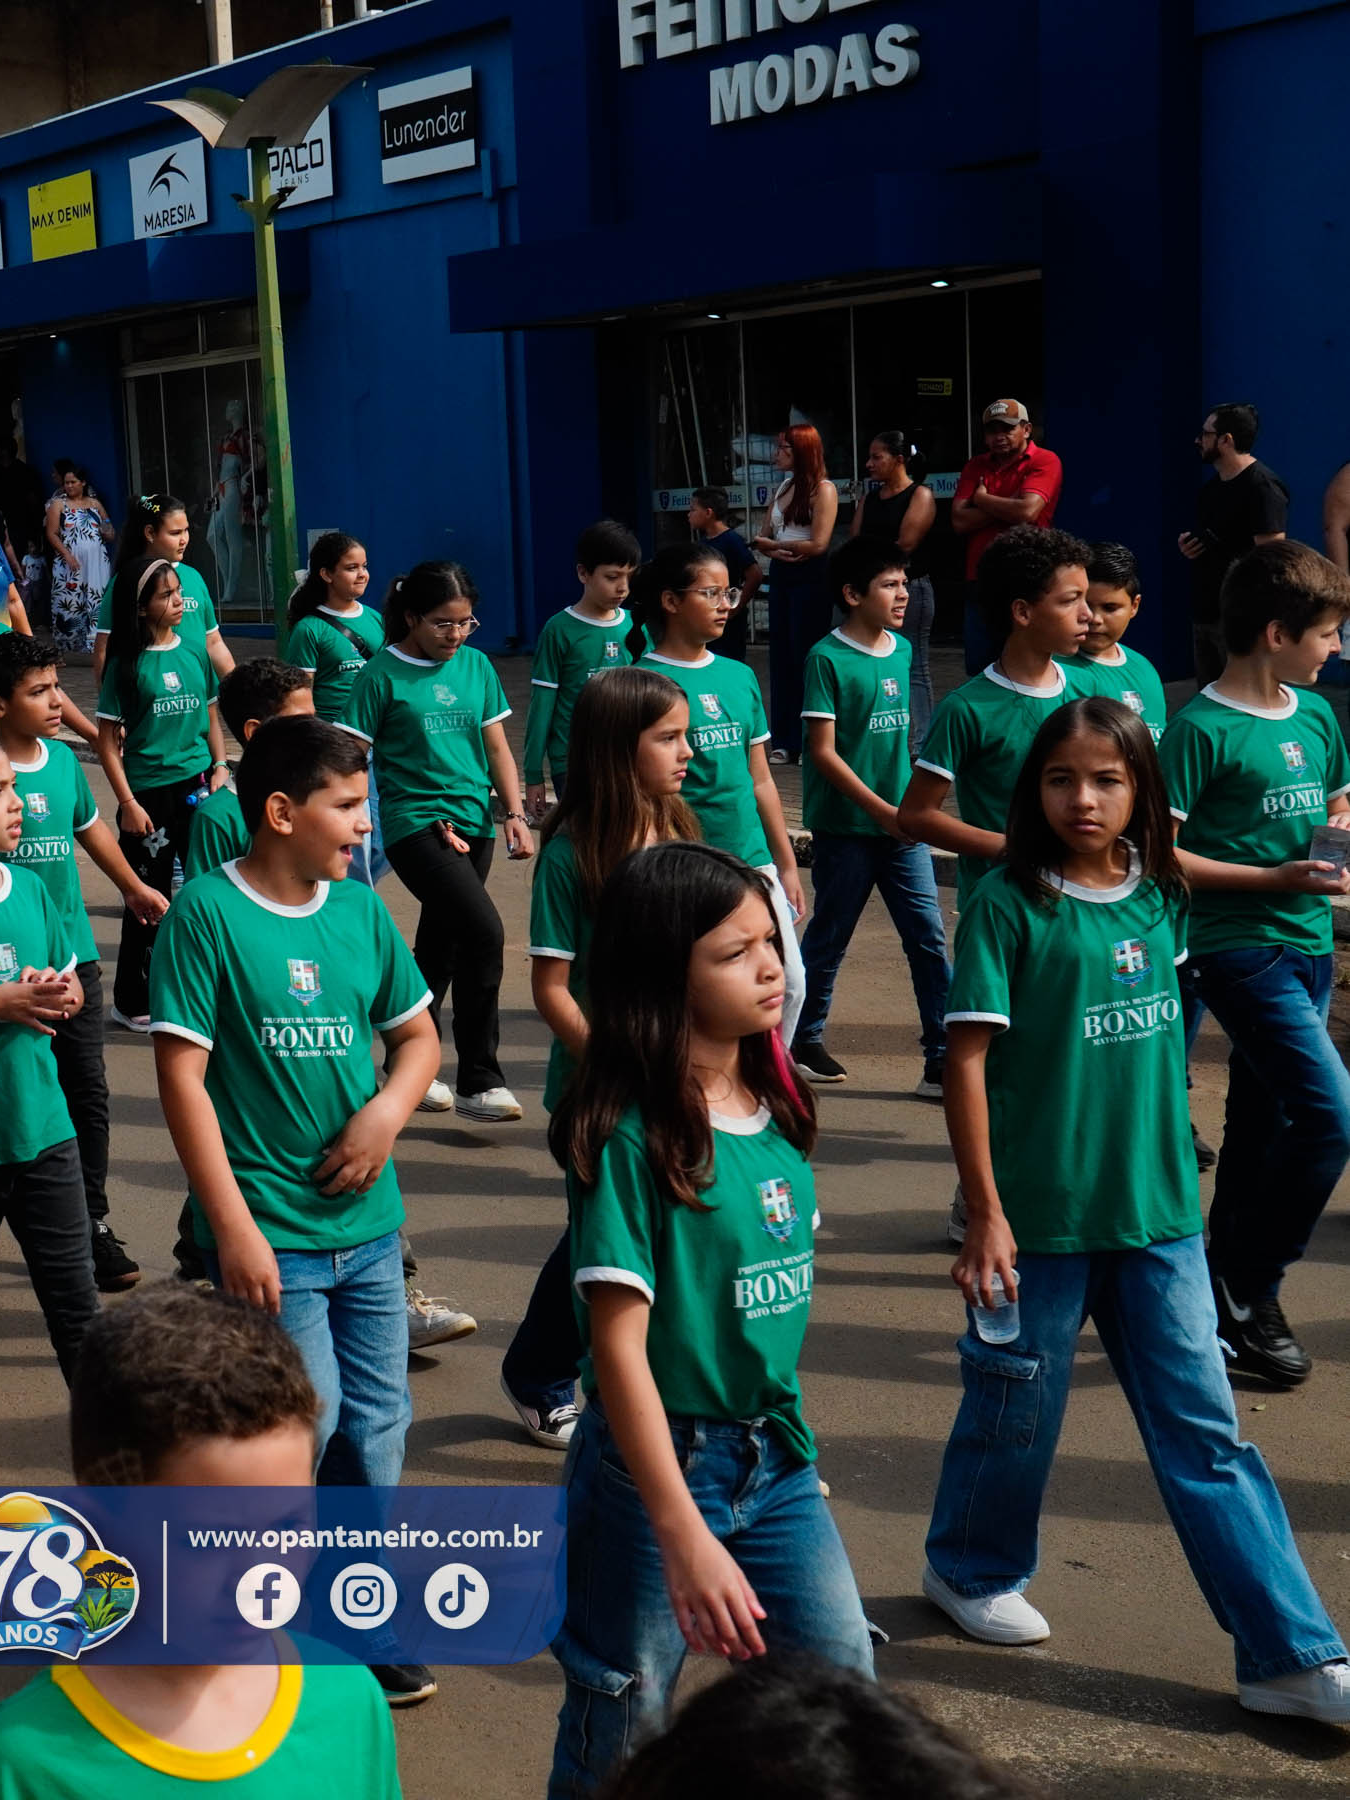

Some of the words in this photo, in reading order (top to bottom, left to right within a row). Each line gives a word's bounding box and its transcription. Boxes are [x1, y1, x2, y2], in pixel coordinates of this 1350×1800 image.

[710, 24, 920, 125] MODAS
[383, 105, 467, 149] Lunender
[267, 138, 325, 181] PACO
[32, 212, 54, 230] MAX
[58, 202, 91, 224] DENIM
[144, 203, 196, 233] MARESIA
[153, 698, 199, 713] BONITO
[424, 715, 477, 729] BONITO
[1083, 998, 1179, 1038] BONITO
[259, 1024, 354, 1048] BONITO
[291, 1049, 321, 1057] GROSSO
[732, 1262, 813, 1308] BONIT
